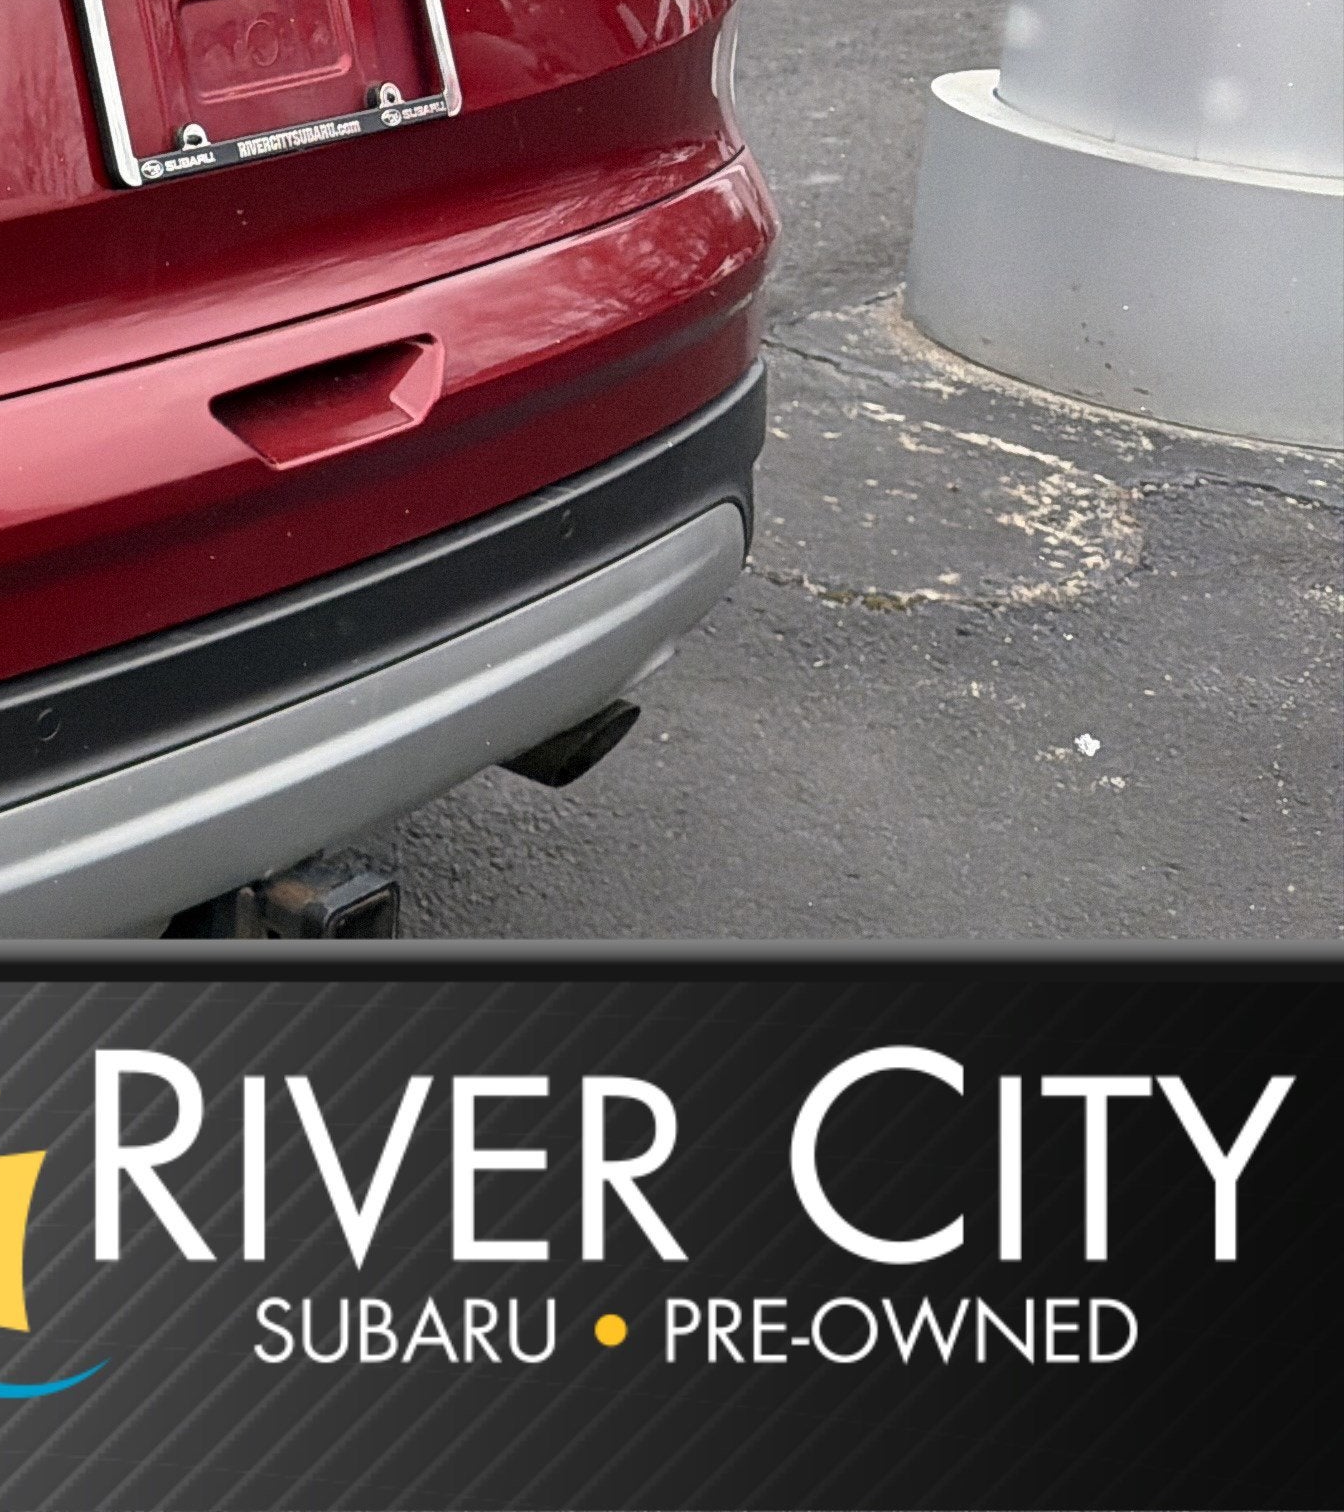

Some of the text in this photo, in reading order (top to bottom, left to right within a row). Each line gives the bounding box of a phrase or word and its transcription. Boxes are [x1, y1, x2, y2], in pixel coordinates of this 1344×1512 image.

[401, 101, 448, 120] SUBARU
[236, 119, 362, 159] RIVERCITYSUBARU.com
[164, 150, 217, 172] SUBARU
